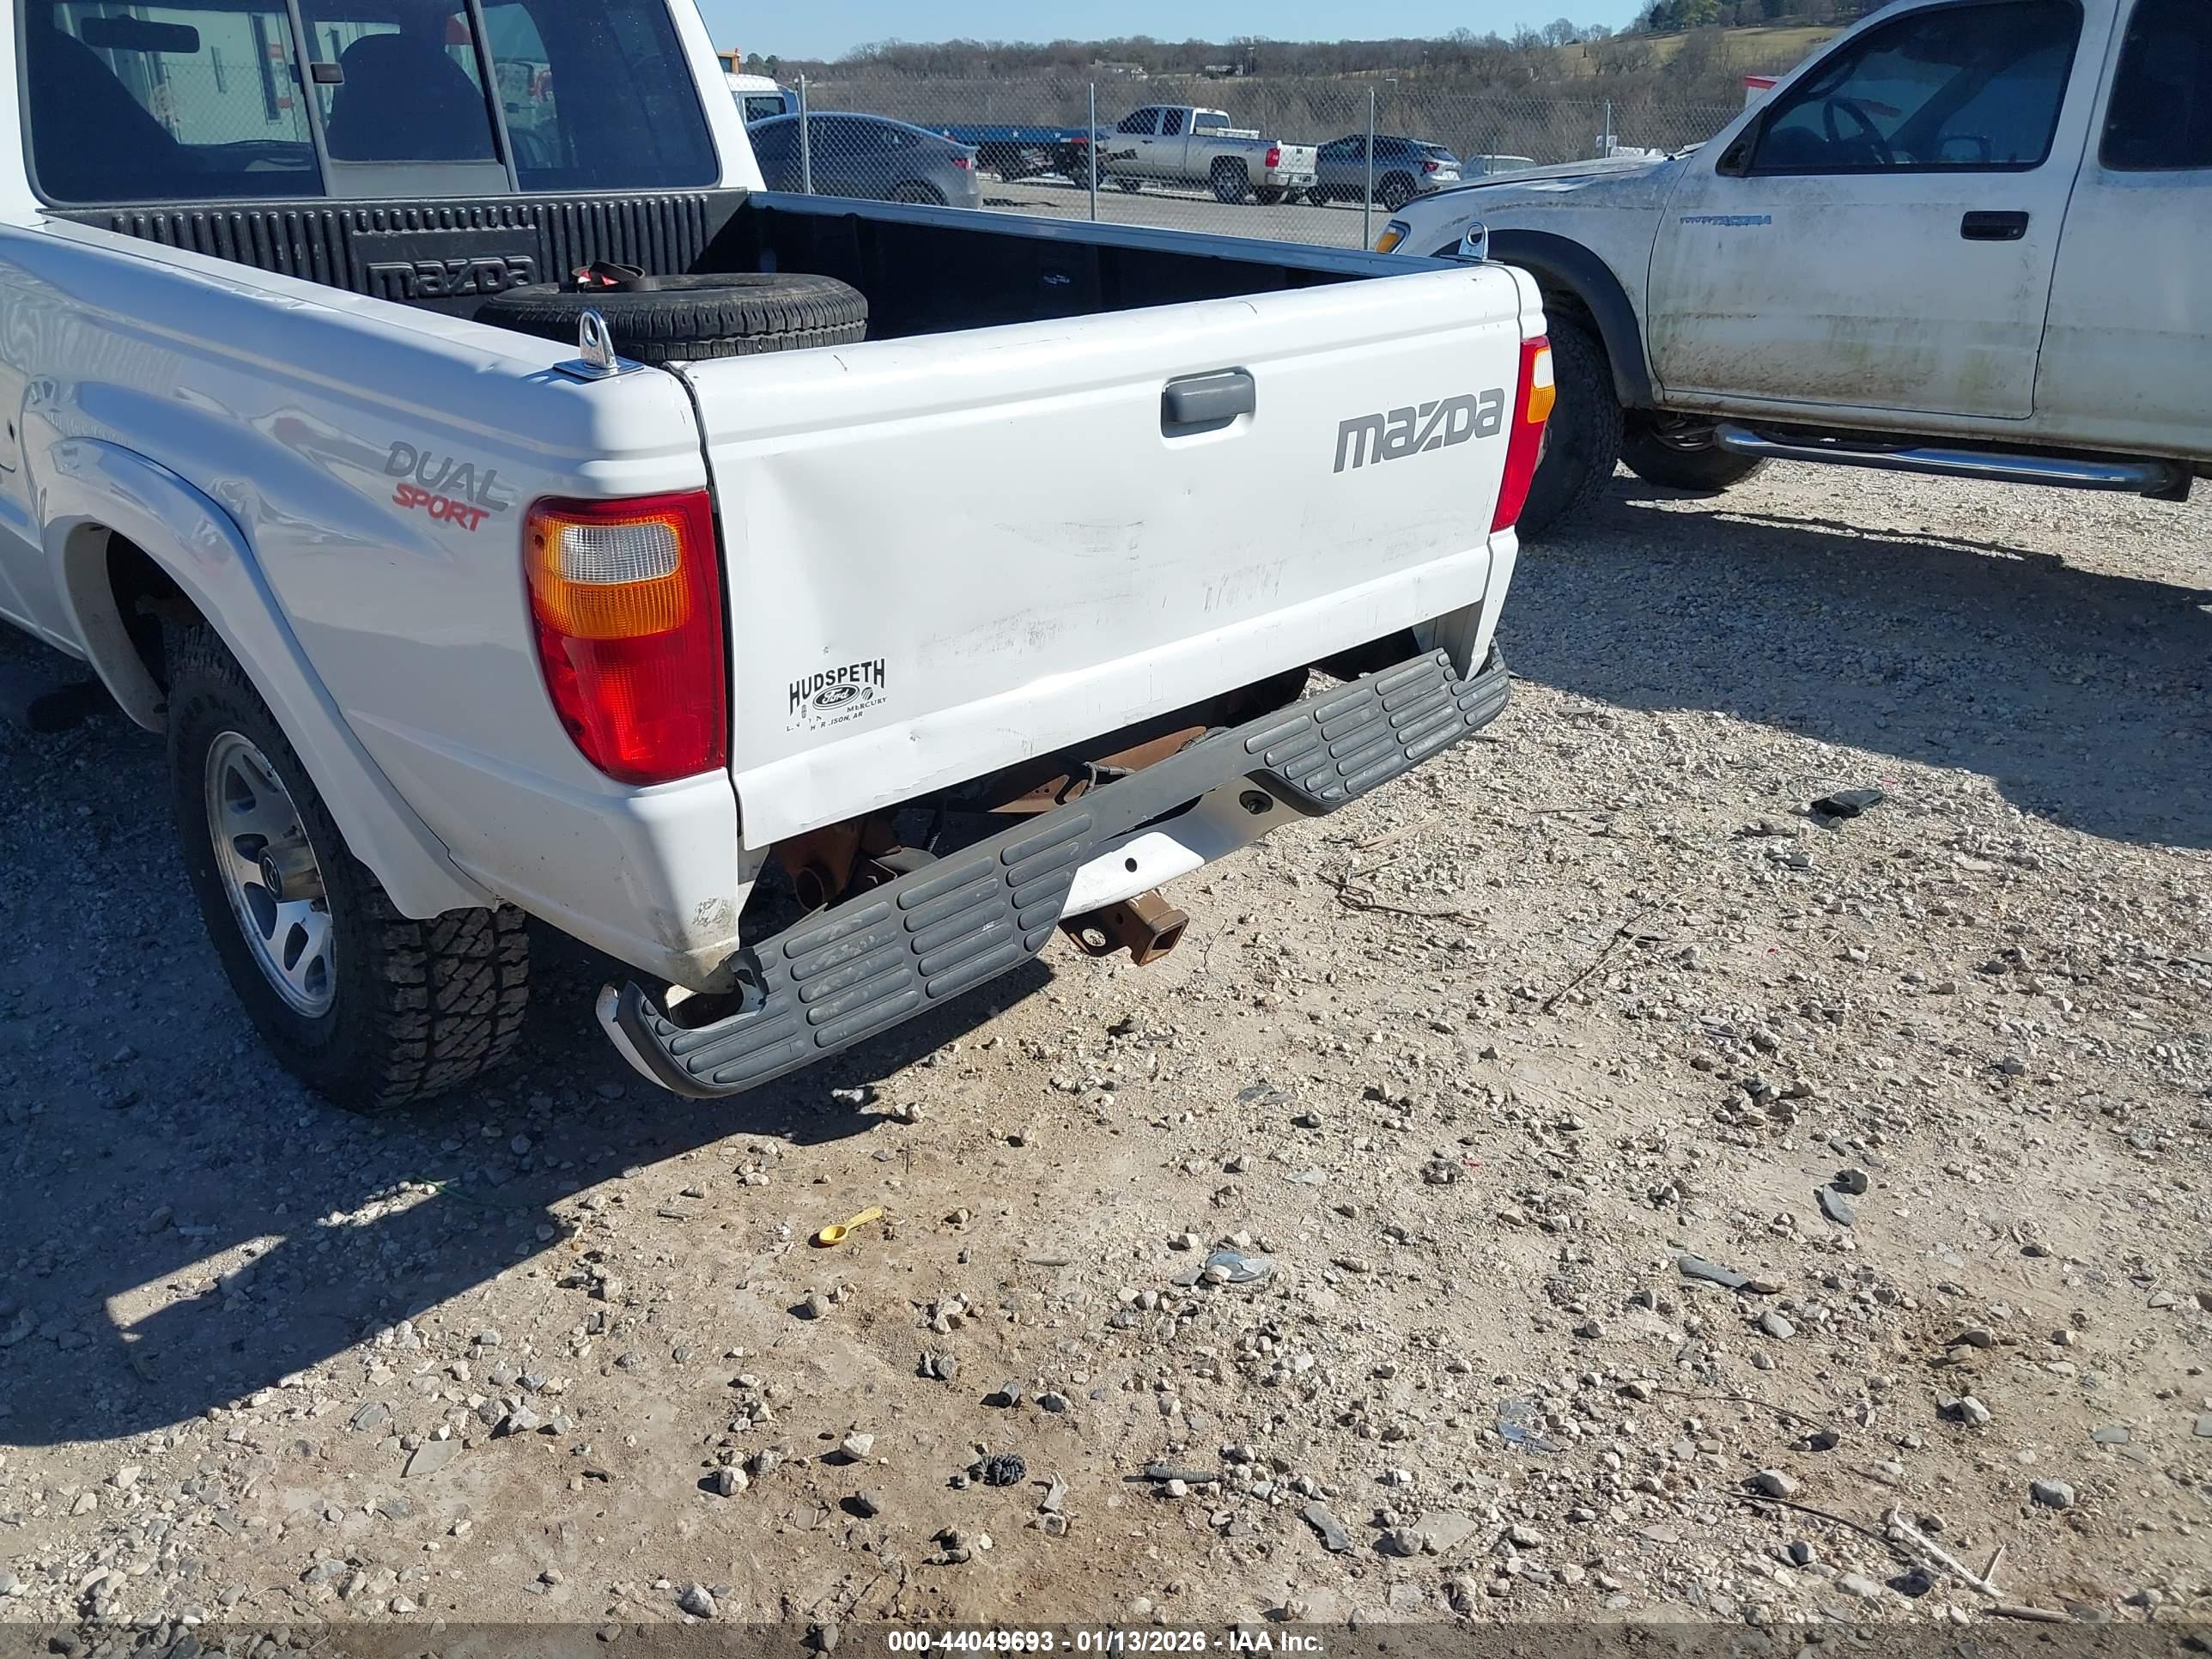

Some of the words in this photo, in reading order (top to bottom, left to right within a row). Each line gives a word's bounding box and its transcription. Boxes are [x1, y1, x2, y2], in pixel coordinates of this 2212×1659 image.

[385, 441, 509, 512] DUAL
[392, 482, 490, 532] SPORT
[788, 658, 885, 717] HUDSPETH
[847, 697, 887, 713] MERCURY
